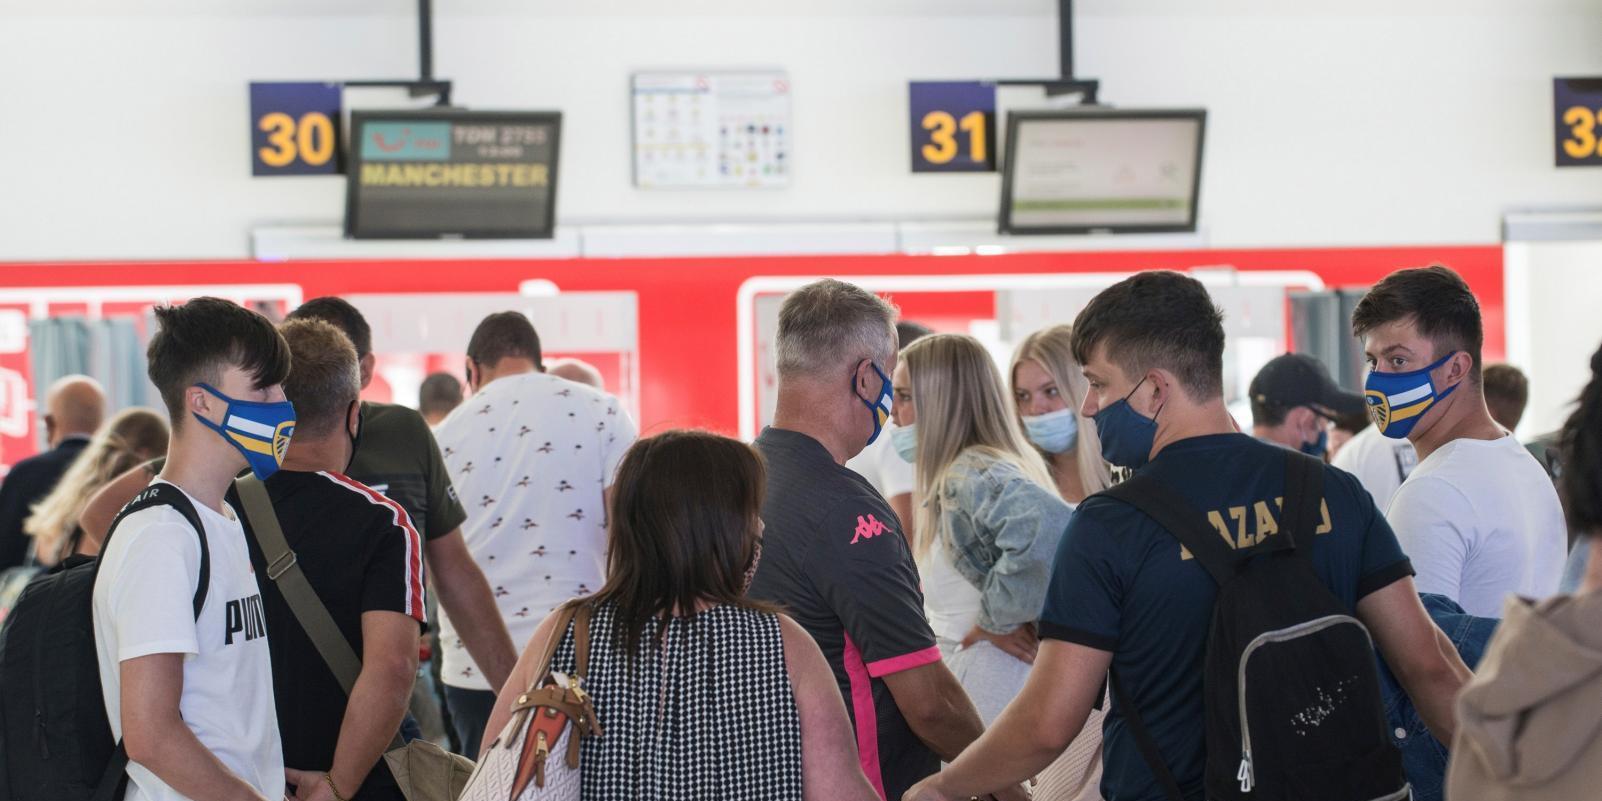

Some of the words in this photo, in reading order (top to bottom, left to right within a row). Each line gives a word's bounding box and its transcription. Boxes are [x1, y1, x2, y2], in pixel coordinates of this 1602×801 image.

[258, 111, 335, 167] 30
[921, 110, 986, 165] 31
[1562, 105, 1602, 159] 3
[361, 163, 548, 187] MANCHESTER
